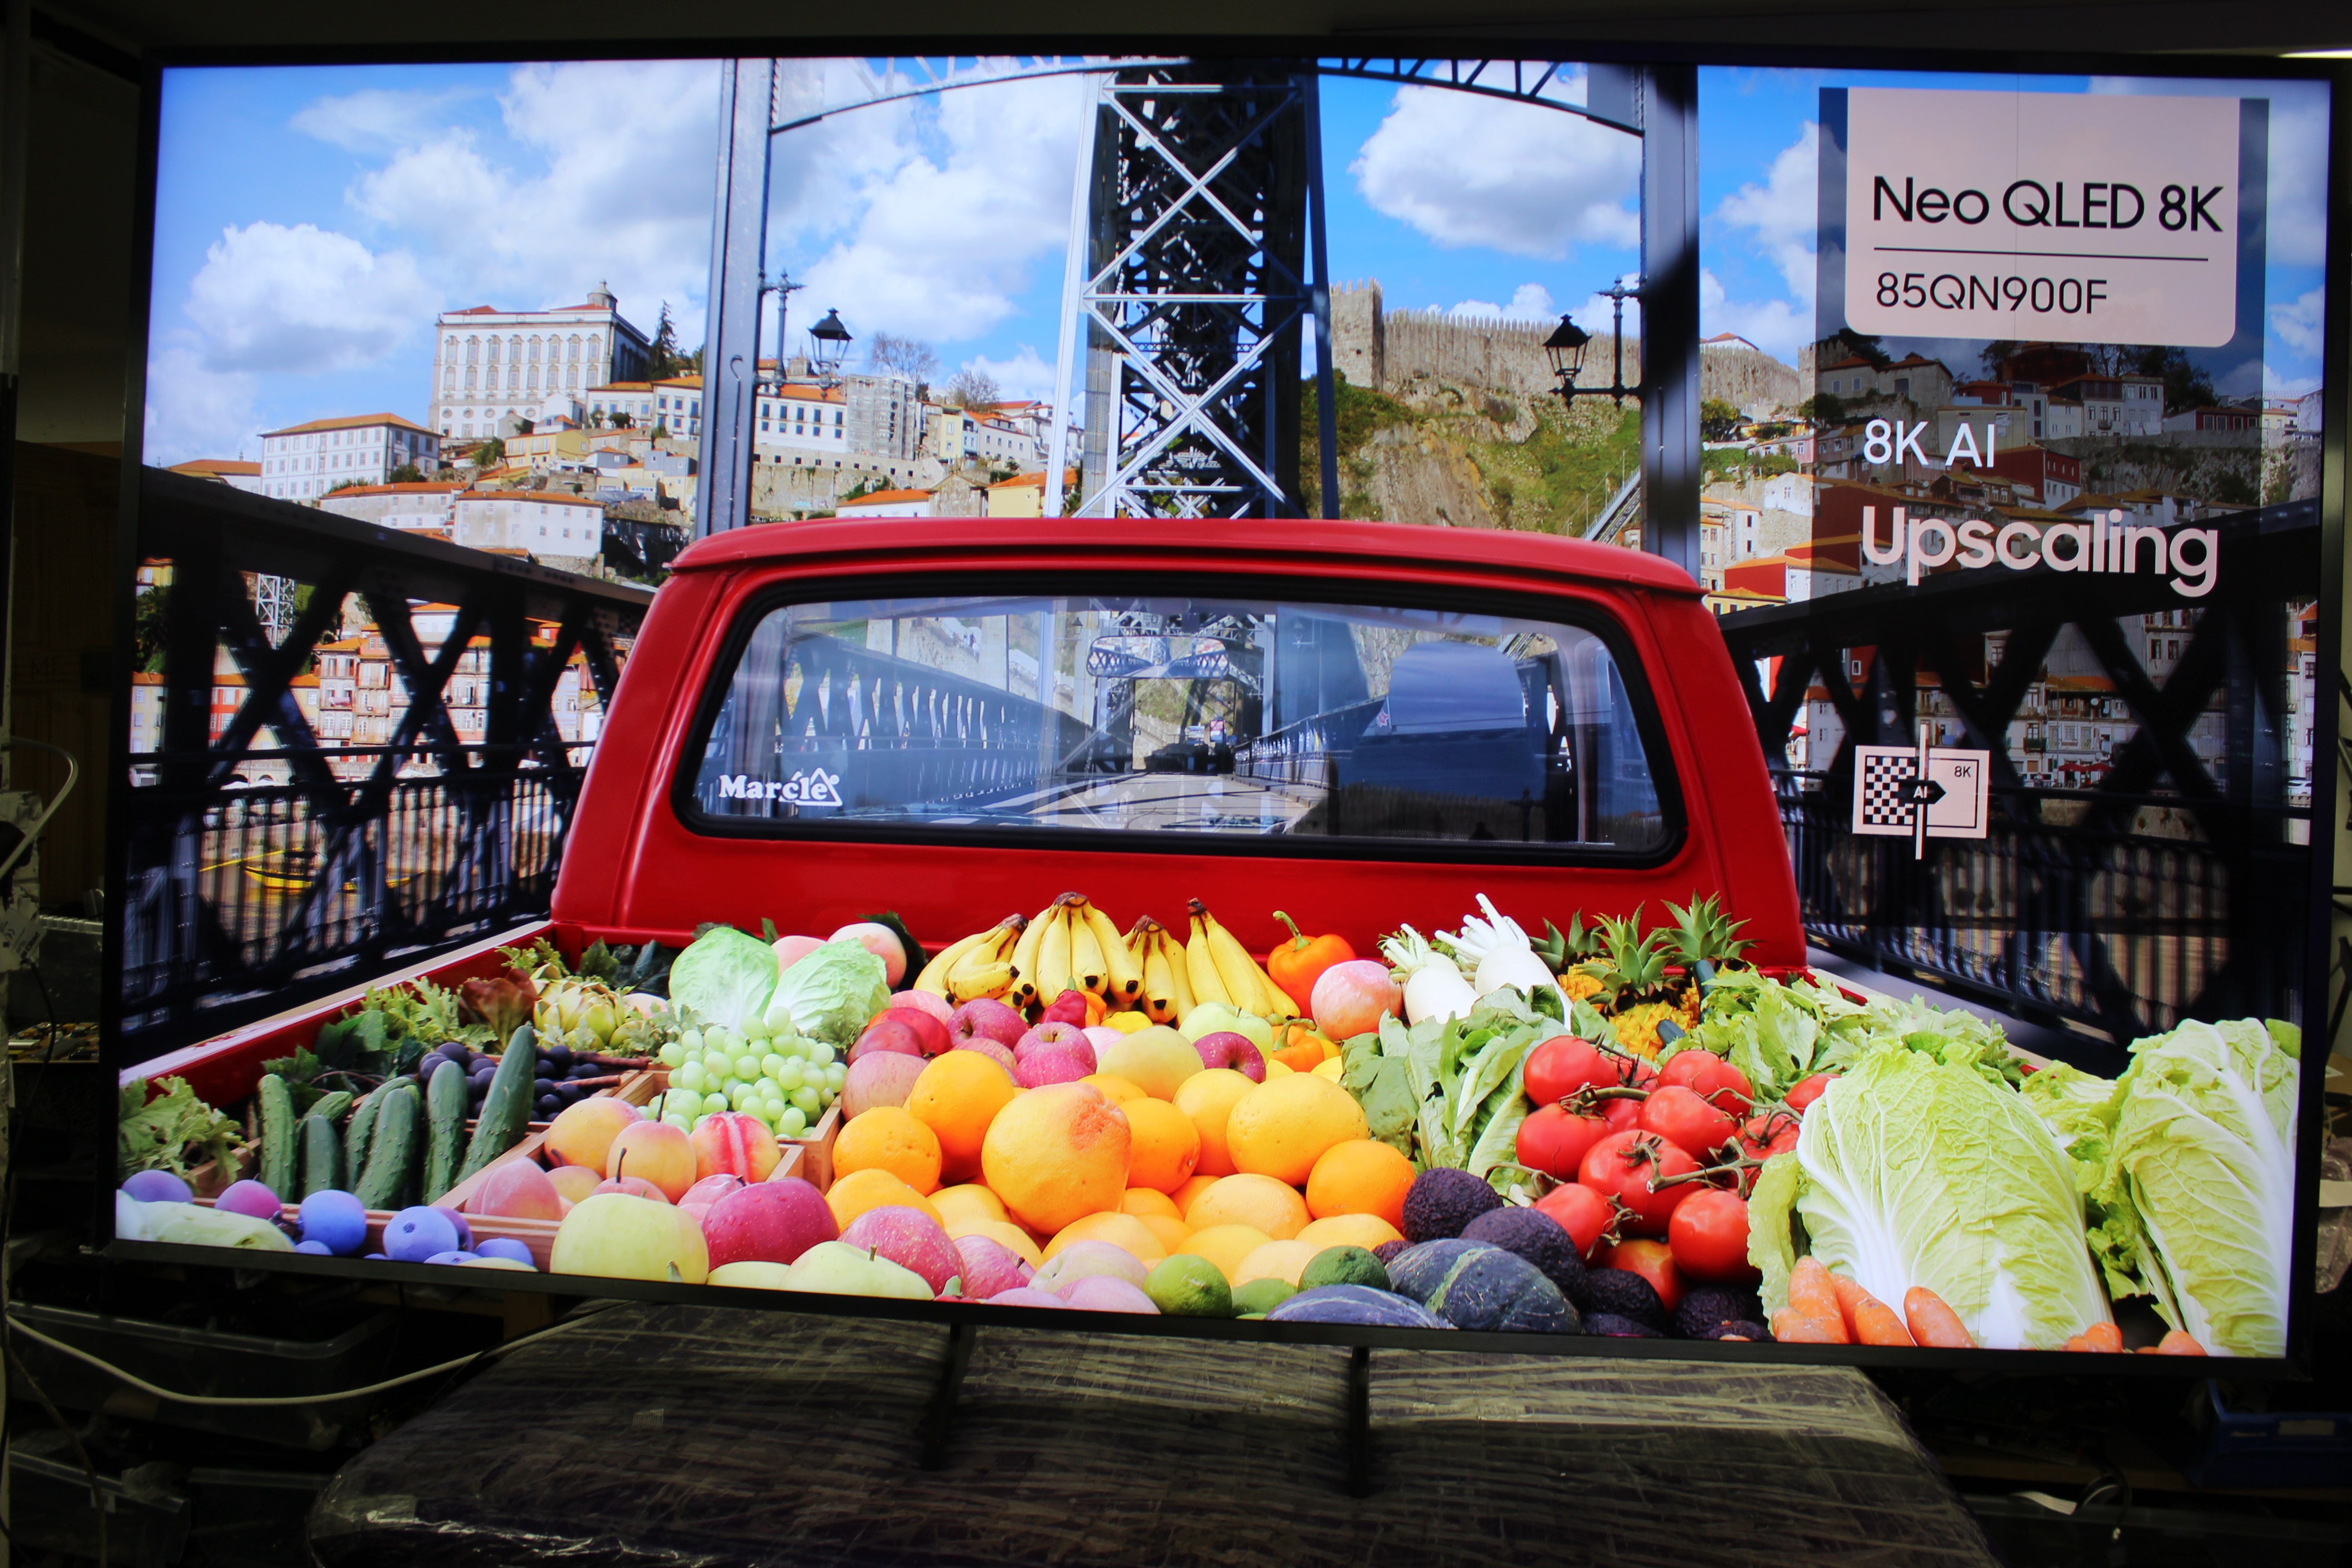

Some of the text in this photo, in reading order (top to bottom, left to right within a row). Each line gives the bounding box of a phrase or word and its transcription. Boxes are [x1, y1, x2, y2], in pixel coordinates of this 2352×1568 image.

[1874, 176, 2224, 232] Neo QLED 8K
[1877, 272, 2107, 314] 85QN900F
[1863, 419, 1995, 468] 8K AI
[1862, 506, 2218, 598] Upscaling
[1913, 786, 1928, 799] AI
[1954, 766, 1971, 778] 8K
